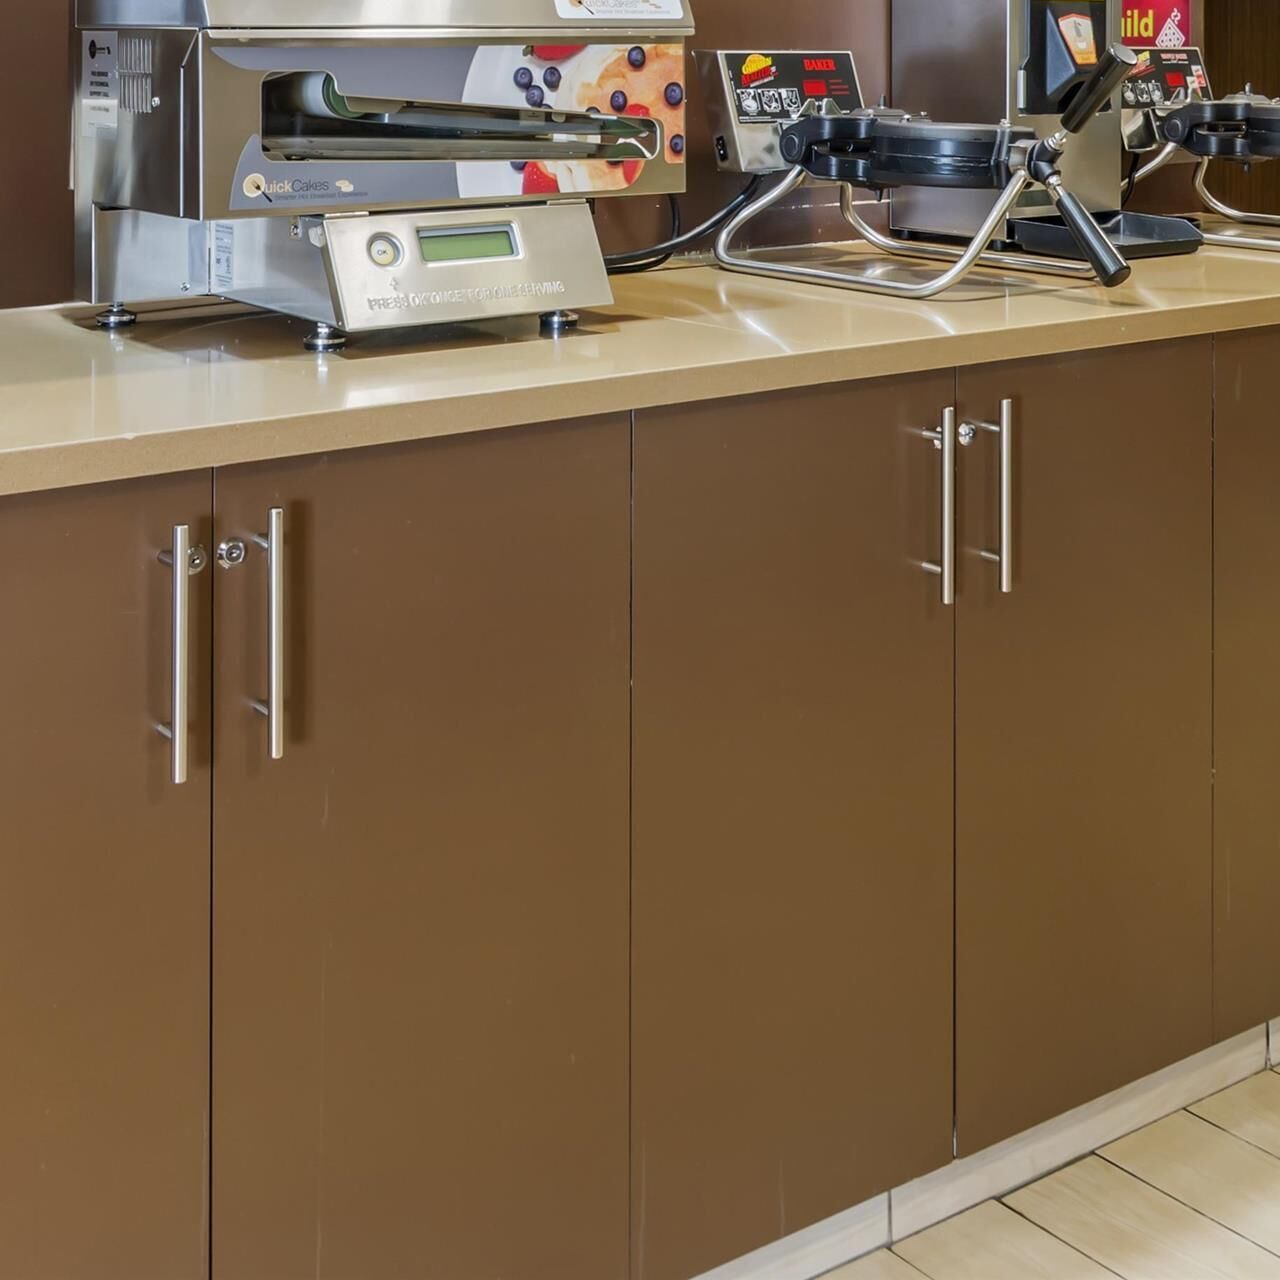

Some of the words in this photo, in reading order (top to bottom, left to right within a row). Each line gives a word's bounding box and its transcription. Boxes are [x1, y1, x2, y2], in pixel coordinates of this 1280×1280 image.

[803, 58, 837, 71] BAKER
[367, 295, 409, 311] PRESS
[409, 293, 425, 306] OK
[467, 288, 492, 302] FOR
[493, 285, 517, 299] ONE
[517, 280, 565, 297] SERVING
